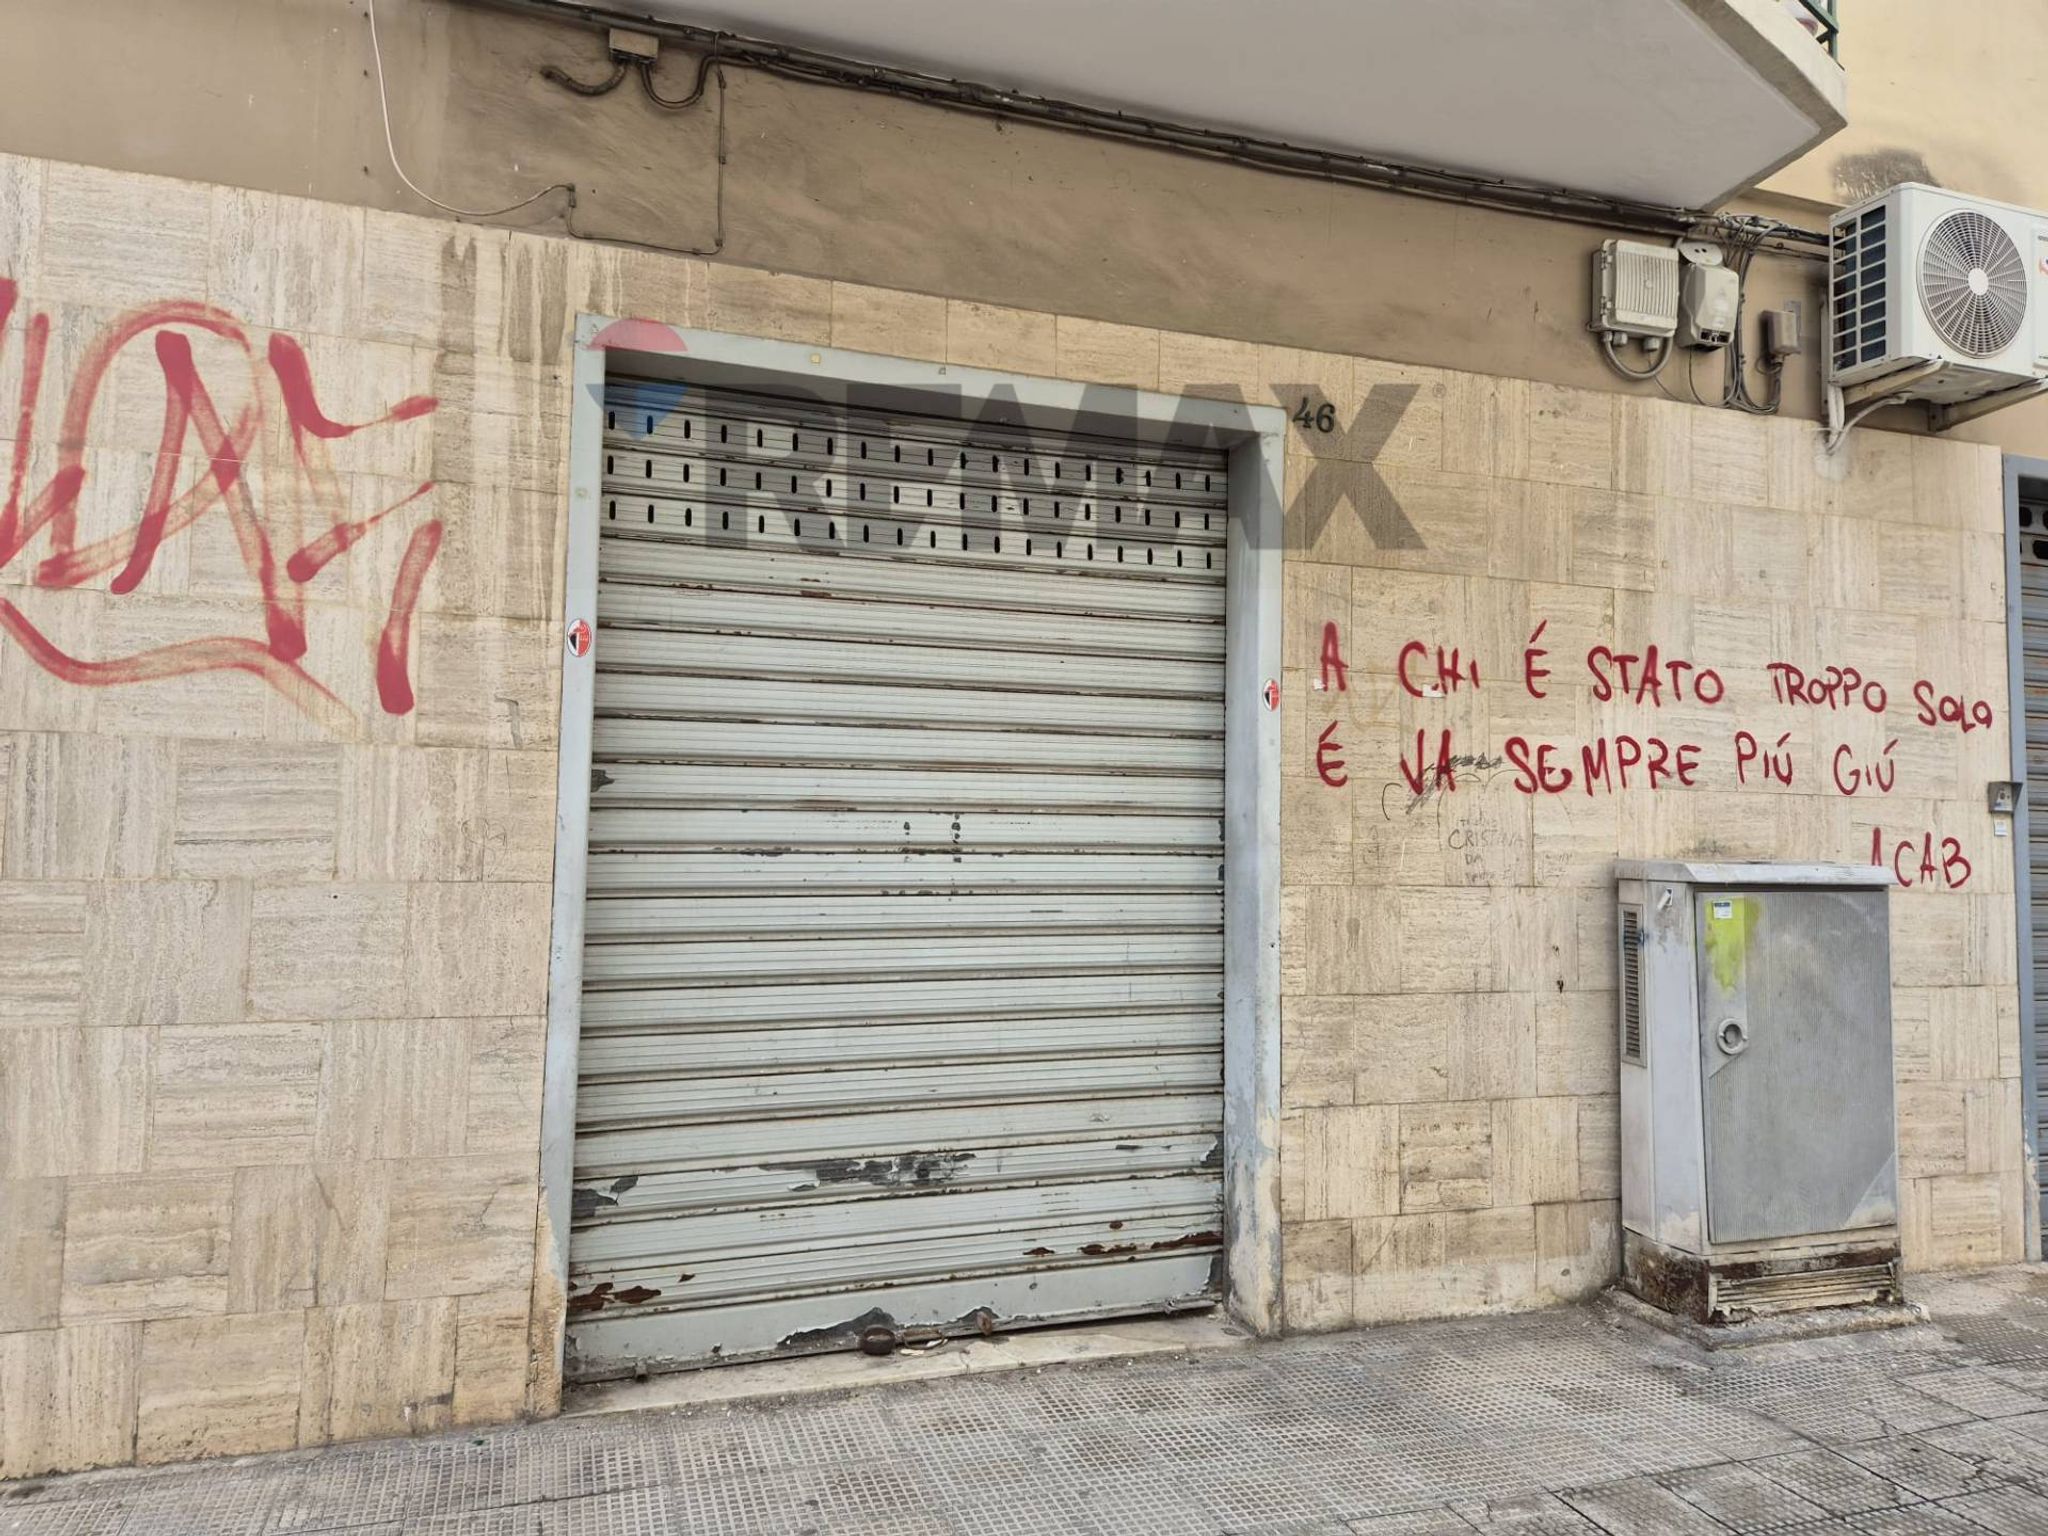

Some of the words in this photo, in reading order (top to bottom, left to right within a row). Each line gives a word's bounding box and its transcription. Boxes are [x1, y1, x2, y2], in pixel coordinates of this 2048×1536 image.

[1292, 396, 1336, 433] 46
[1319, 621, 1349, 692] A
[1398, 640, 1480, 698] CHI
[1587, 644, 1725, 707] STATO
[1767, 662, 1888, 714] TROPPO
[1400, 728, 1457, 795] VA
[1504, 735, 1702, 797] SEMPRE
[1871, 827, 1972, 888] ACAB
